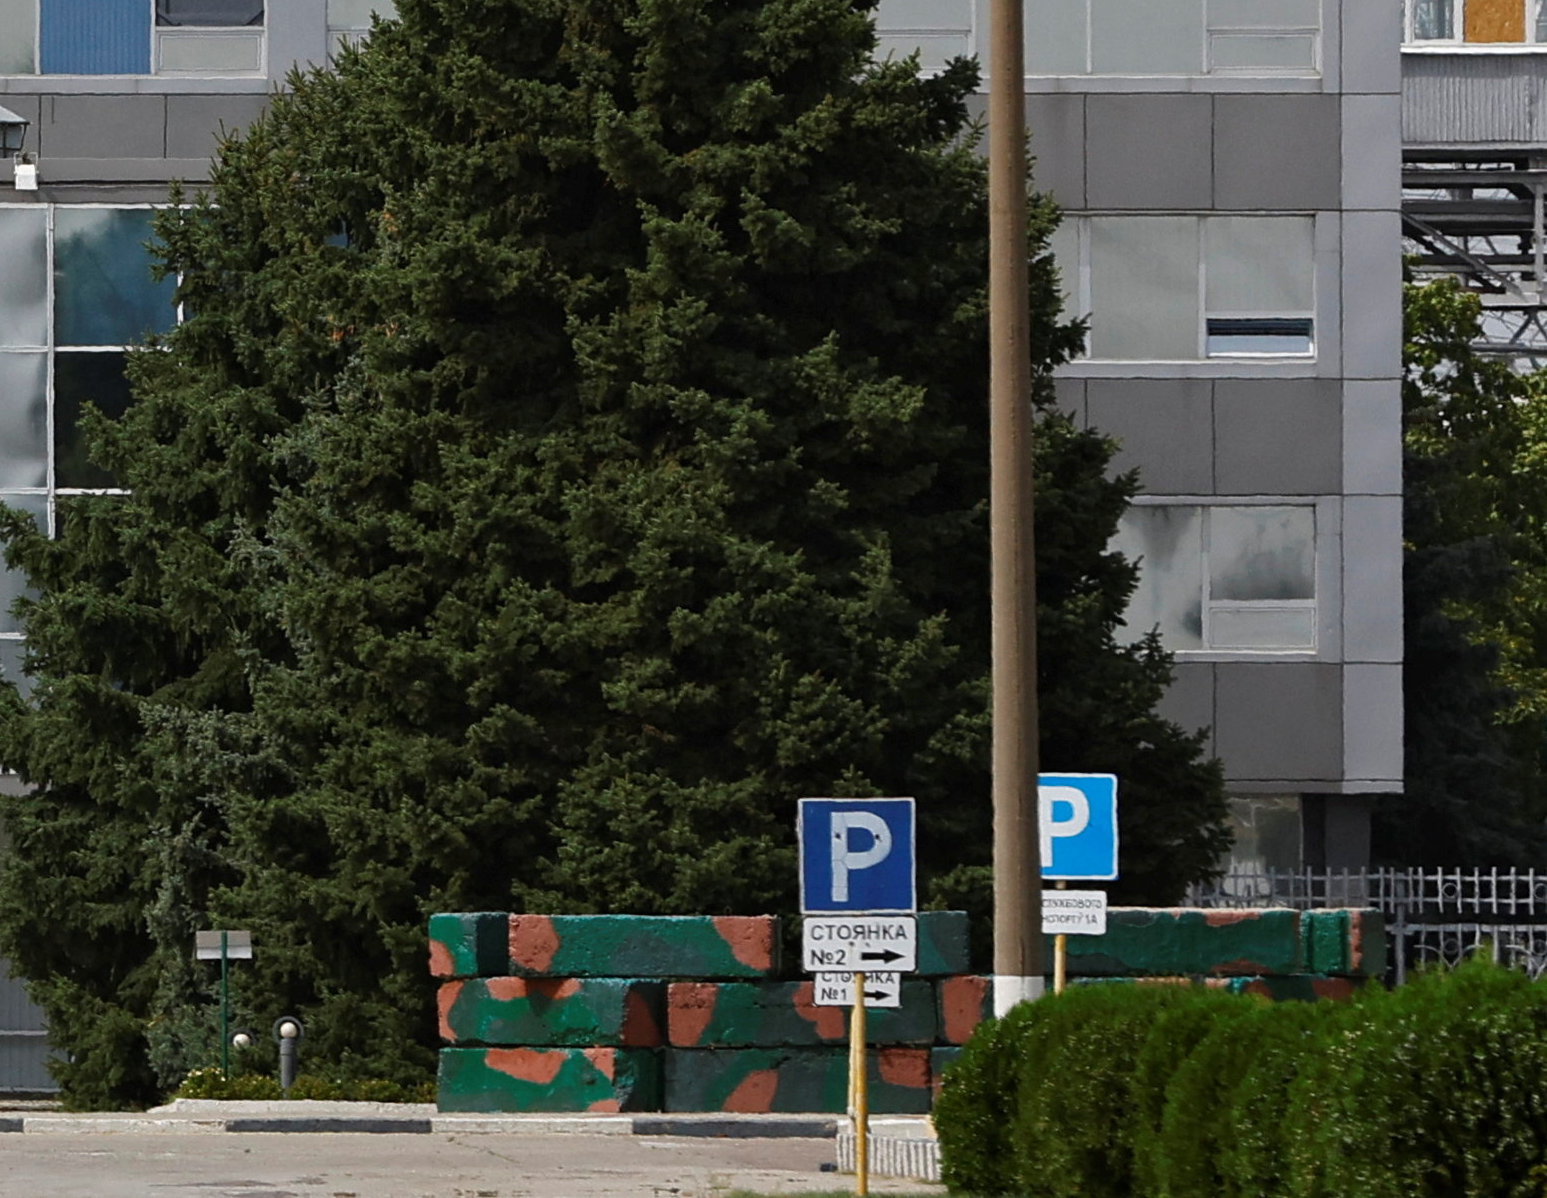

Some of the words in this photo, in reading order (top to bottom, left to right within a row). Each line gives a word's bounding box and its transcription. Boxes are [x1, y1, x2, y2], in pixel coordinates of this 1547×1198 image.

[830, 810, 893, 903] P
[810, 923, 908, 942] СТОЯНКА
[821, 971, 896, 984] СТОНКА
